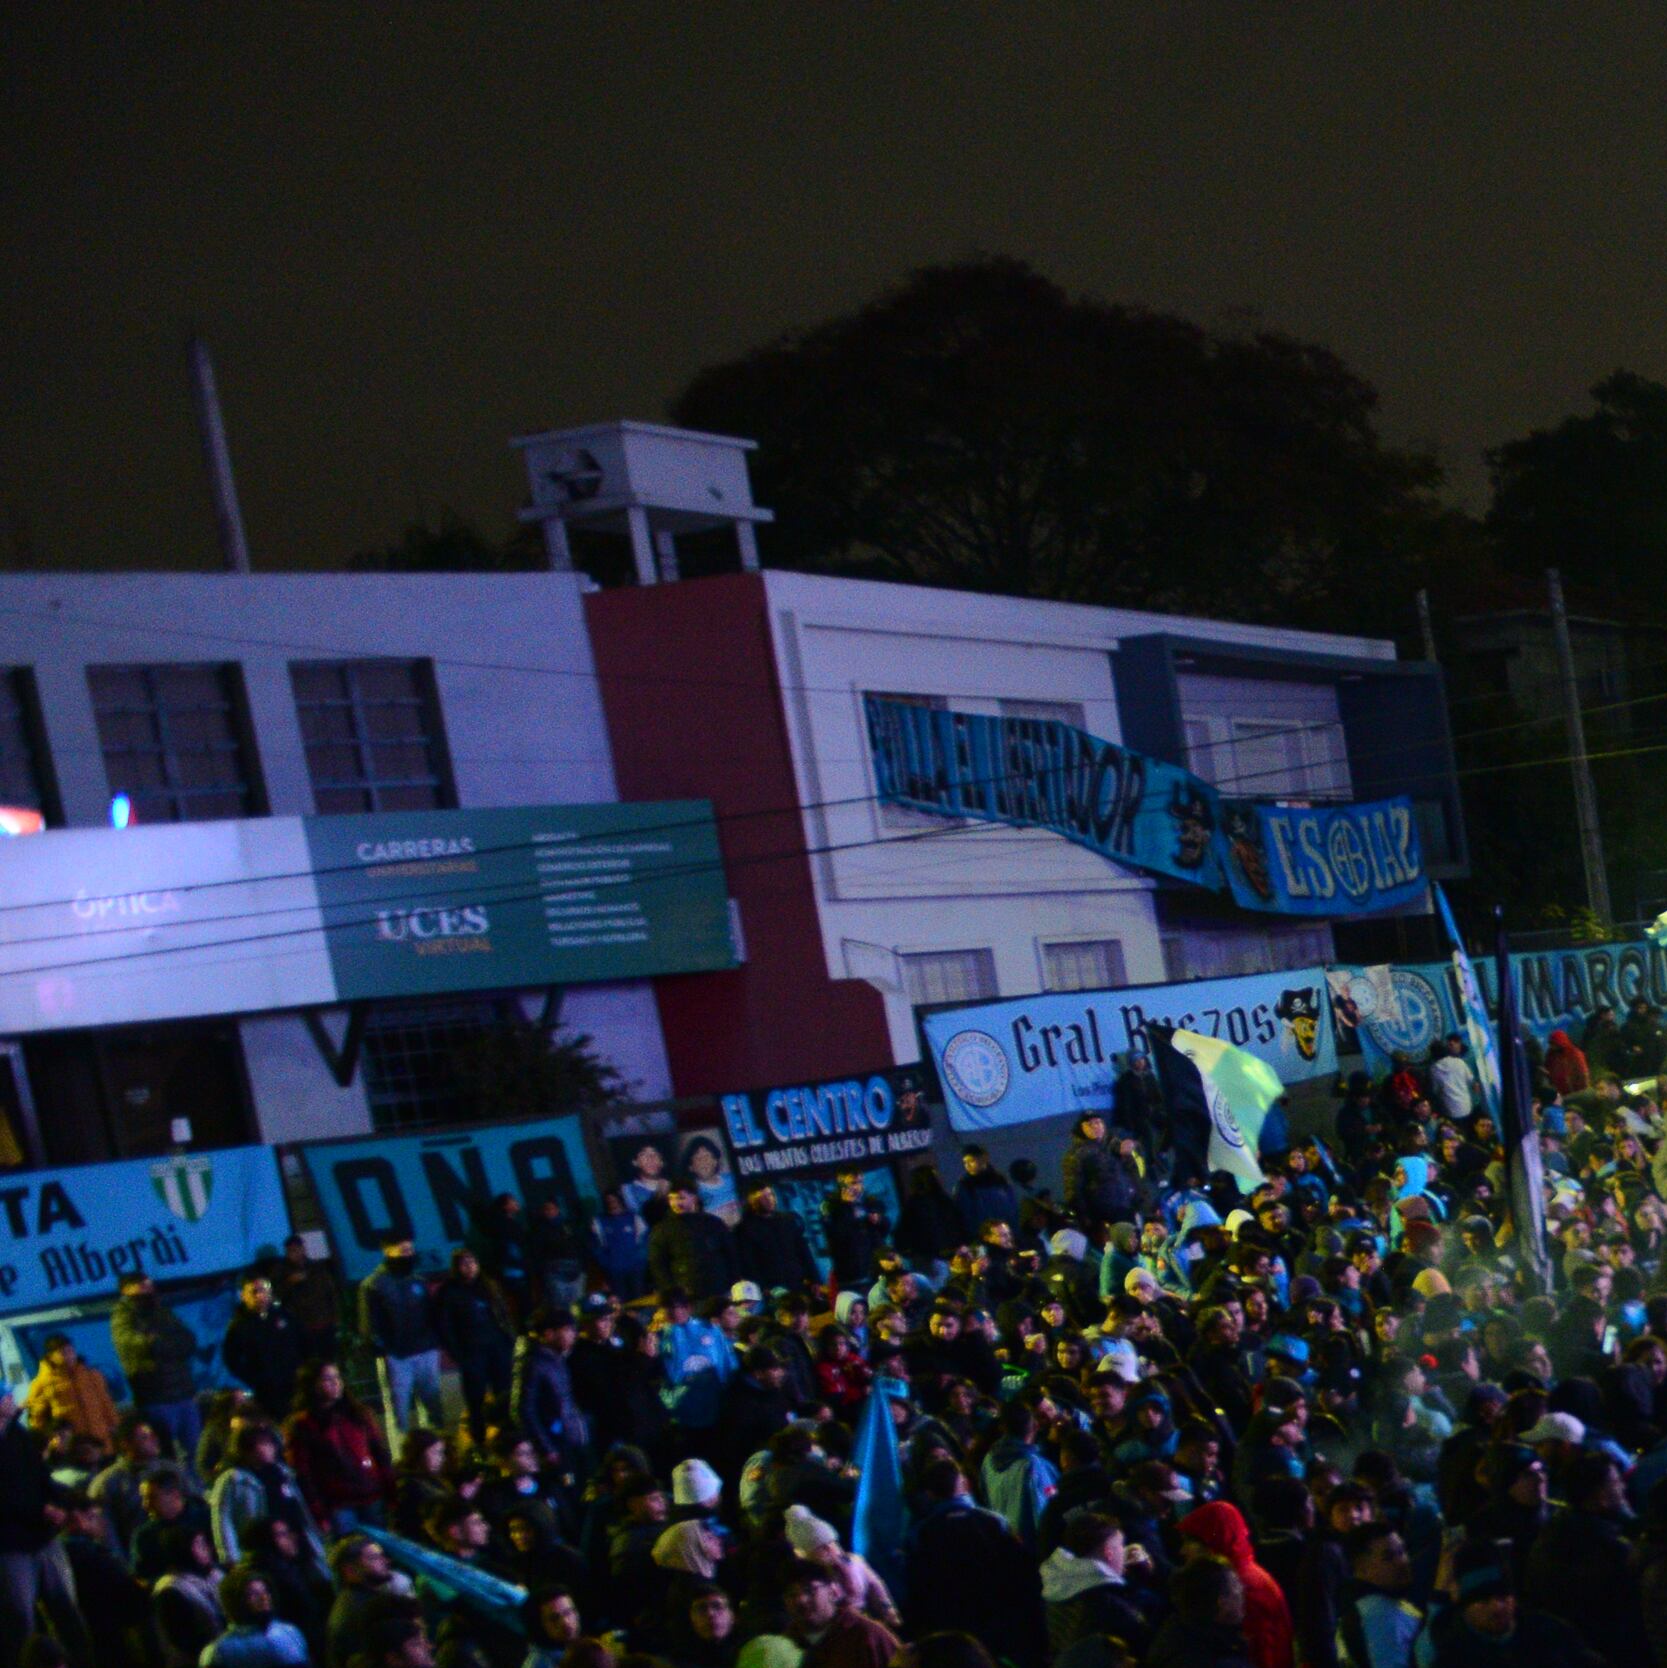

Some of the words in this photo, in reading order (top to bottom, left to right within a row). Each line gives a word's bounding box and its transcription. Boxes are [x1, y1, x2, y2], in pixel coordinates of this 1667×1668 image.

[357, 836, 475, 861] CARRERAS
[71, 888, 180, 918] ÓPTICA
[376, 905, 490, 941] UCES
[1011, 1007, 1119, 1073] Gral.
[720, 1092, 767, 1149] EL
[766, 1074, 894, 1143] CENTRO
[40, 1225, 190, 1289] Alberdi
